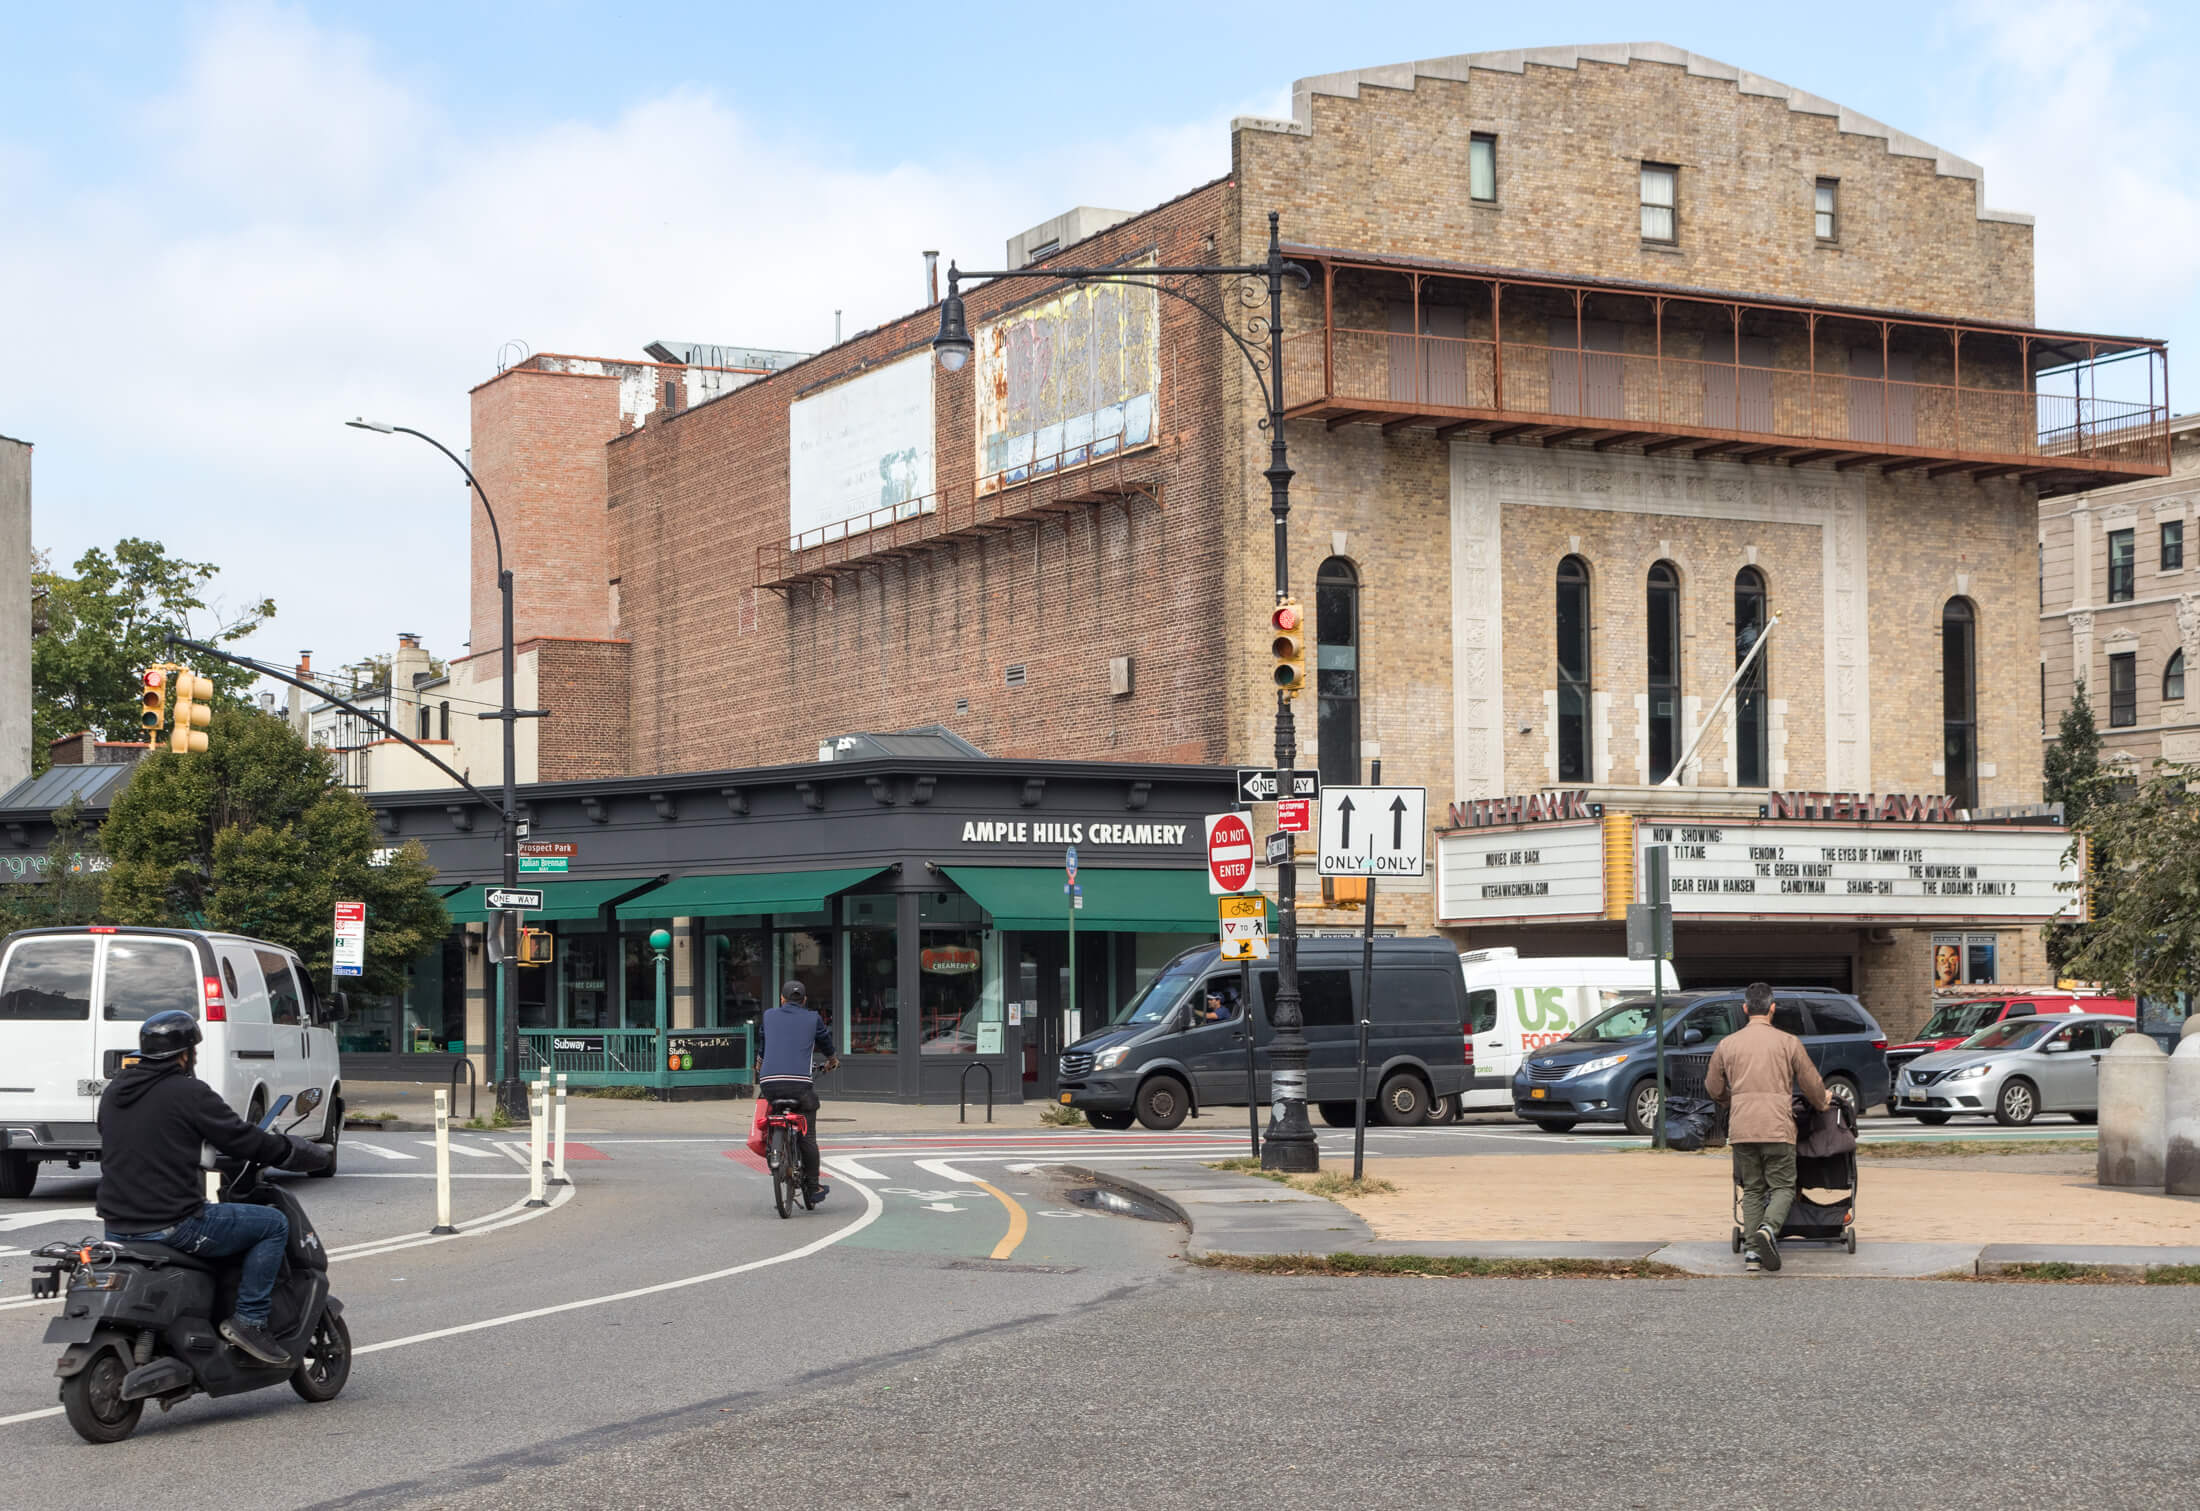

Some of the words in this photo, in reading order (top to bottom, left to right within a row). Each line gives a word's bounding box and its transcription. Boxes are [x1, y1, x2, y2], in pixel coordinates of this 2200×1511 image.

[1251, 780, 1275, 793] ONE
[1293, 780, 1309, 792] AY
[1449, 790, 1589, 828] NITEHAWK
[1768, 790, 1957, 822] NITEHAWK
[962, 821, 1027, 842] AMPLE
[1033, 823, 1083, 843] HILLS
[1088, 823, 1186, 845] CREAMERY
[1215, 831, 1228, 843] DO
[1229, 829, 1245, 842] NOT
[1653, 829, 1673, 842] NOW
[1681, 829, 1723, 843] SHOWING:
[520, 844, 553, 853] Prospect
[554, 843, 572, 852] Park
[1674, 846, 1706, 859] TITANE
[1749, 847, 1776, 860] VENOM
[1778, 847, 1784, 860] 2
[1821, 848, 1836, 861] THE
[1838, 848, 1857, 861] EYES
[1859, 848, 1868, 861] OF
[1872, 849, 1900, 862] TAMMY
[1903, 849, 1923, 863] FAYE
[1325, 856, 1364, 869] ONLY
[1376, 857, 1416, 869] ONLY
[1485, 852, 1507, 866] MOVIES
[1509, 851, 1521, 864] ARE
[1524, 850, 1540, 863] BACK
[1219, 863, 1246, 878] ENTER
[1755, 864, 1771, 876] THE
[1774, 864, 1799, 877] GREEN
[1802, 864, 1833, 877] KNIGHT
[1909, 866, 1923, 878] THE
[1925, 866, 1961, 879] NOWHERE
[1964, 867, 1978, 879] INN
[1481, 882, 1549, 898] NITEHAWKCINEMA.COM
[1672, 879, 1693, 892] DEAR
[1698, 879, 1719, 892] EVAN
[1723, 880, 1755, 893] HANSEN
[1781, 880, 1825, 893] CANDYMAN
[1847, 881, 1893, 894] SHANG-CHI
[1923, 882, 1937, 895] THE
[1941, 882, 1973, 895] ADDAMS
[1977, 882, 2006, 895] FAMILY
[2010, 883, 2016, 896] 2
[493, 894, 511, 903] ONE
[517, 895, 535, 904] WAY
[932, 962, 969, 970] CREAMERY
[554, 1039, 585, 1051] Subway
